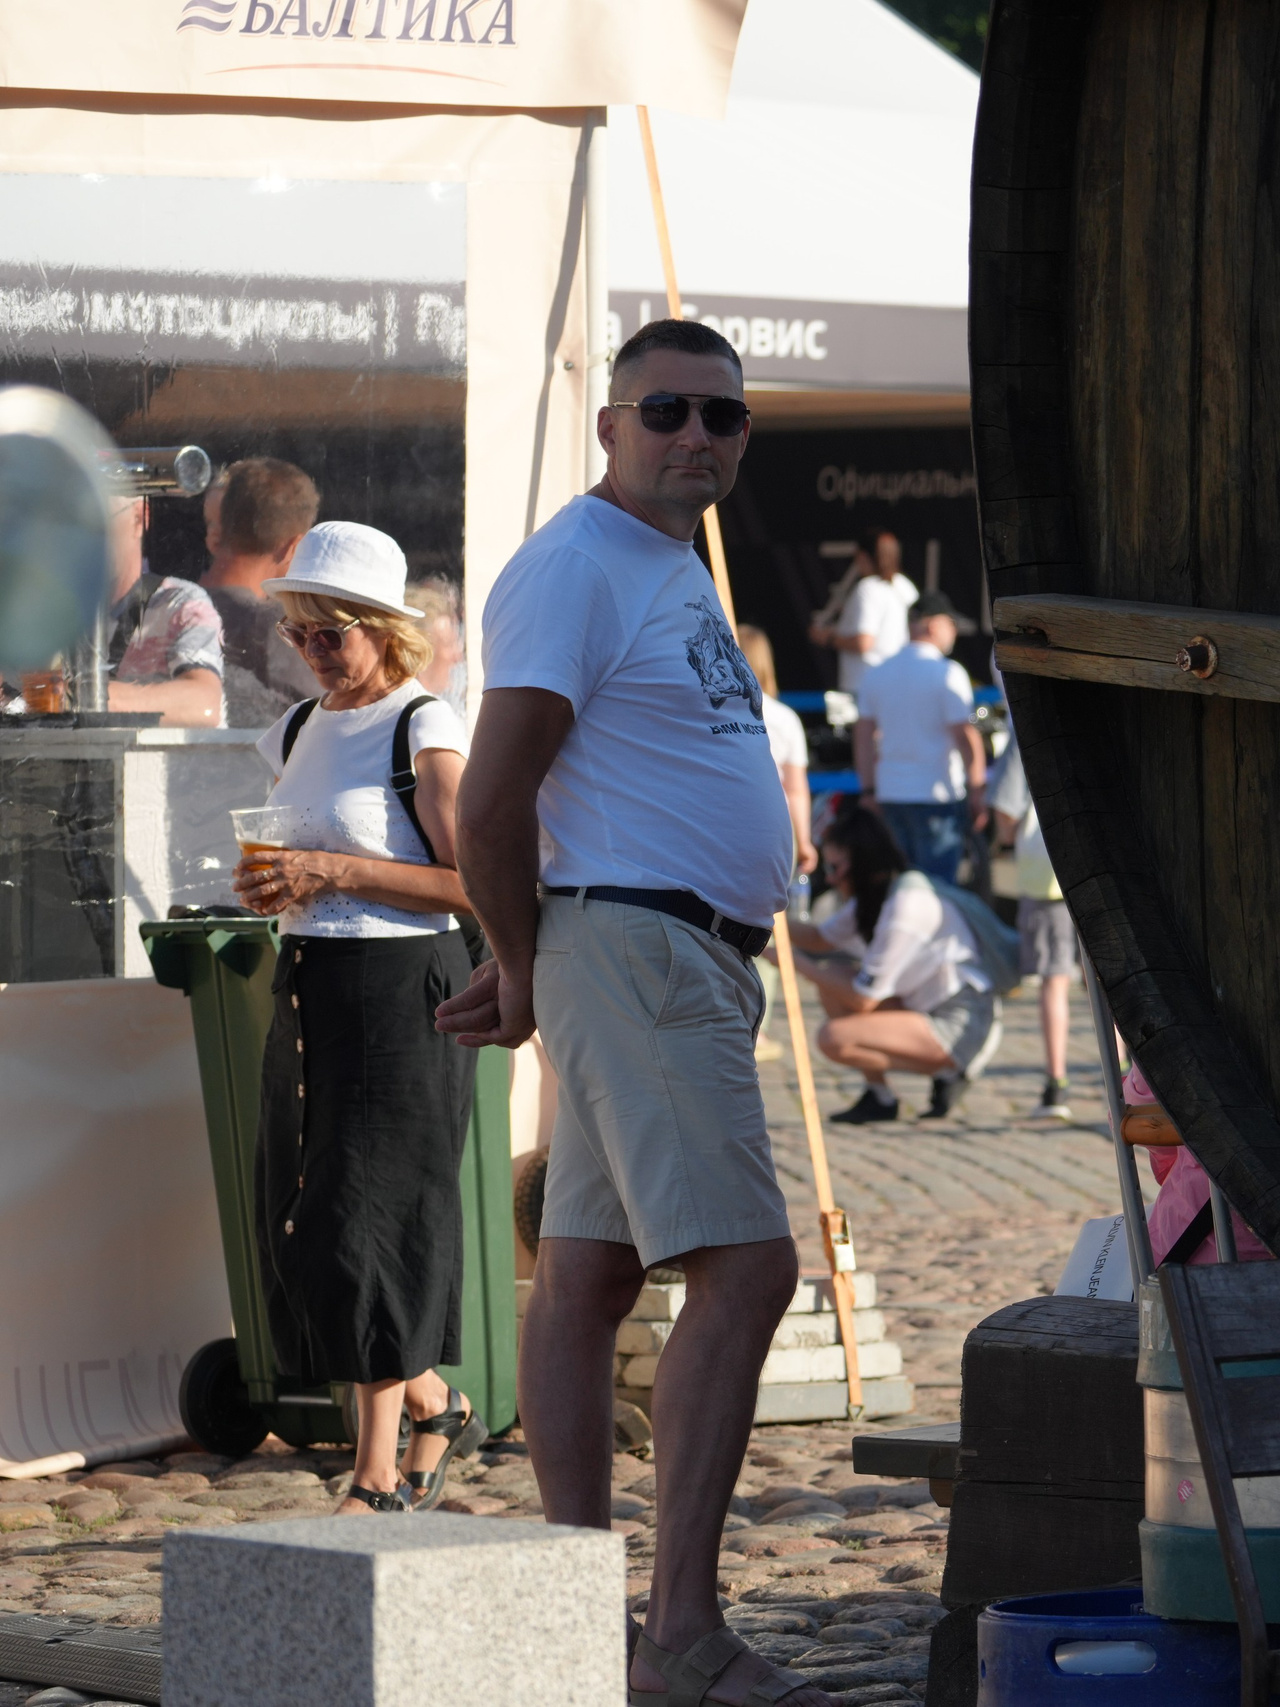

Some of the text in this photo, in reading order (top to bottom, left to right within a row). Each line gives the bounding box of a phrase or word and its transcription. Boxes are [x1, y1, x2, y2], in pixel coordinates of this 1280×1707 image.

[240, 0, 524, 47] БАЛТИКА
[680, 303, 829, 360] рвис
[1103, 1216, 1125, 1247] CALVIN
[1092, 1247, 1111, 1274] KLEIN
